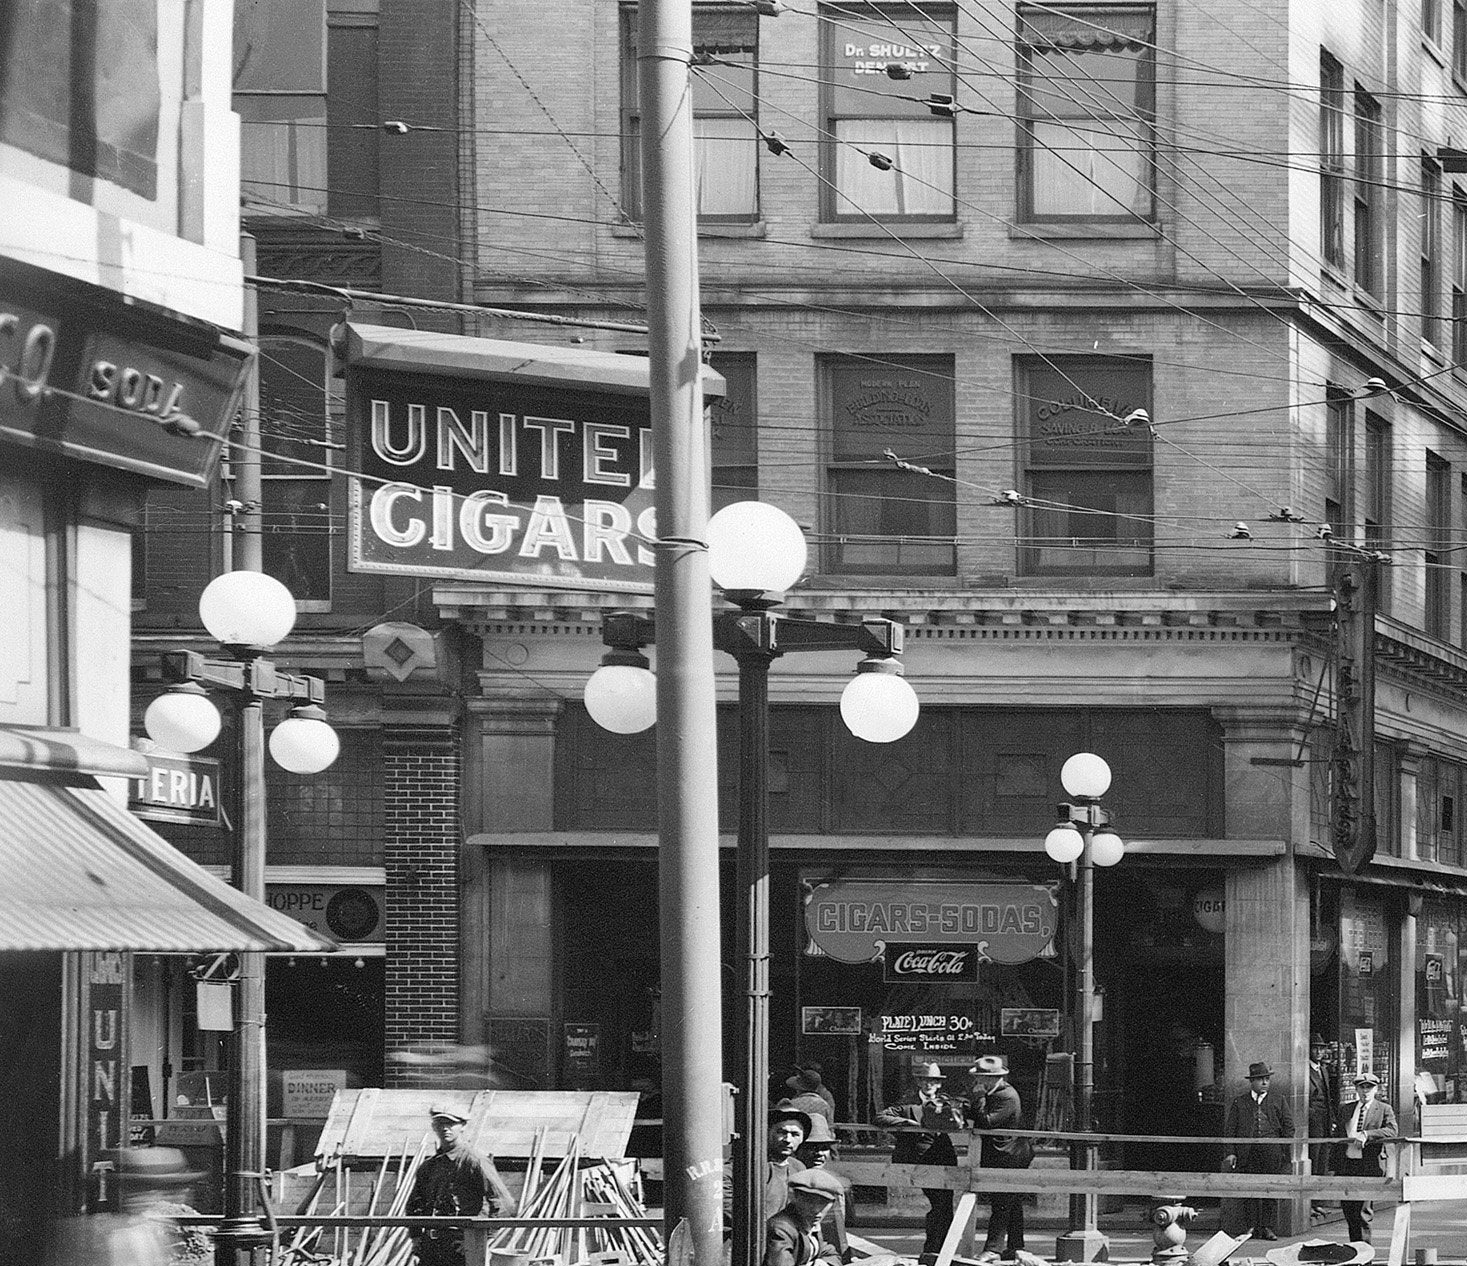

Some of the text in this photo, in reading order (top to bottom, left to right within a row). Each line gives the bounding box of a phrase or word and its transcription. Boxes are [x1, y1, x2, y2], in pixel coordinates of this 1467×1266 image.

[869, 44, 941, 58] SHULTZ
[92, 361, 184, 418] SODA
[881, 1015, 912, 1032] PLATE
[911, 1015, 946, 1032] LUNCH
[287, 1082, 336, 1095] DINNER
